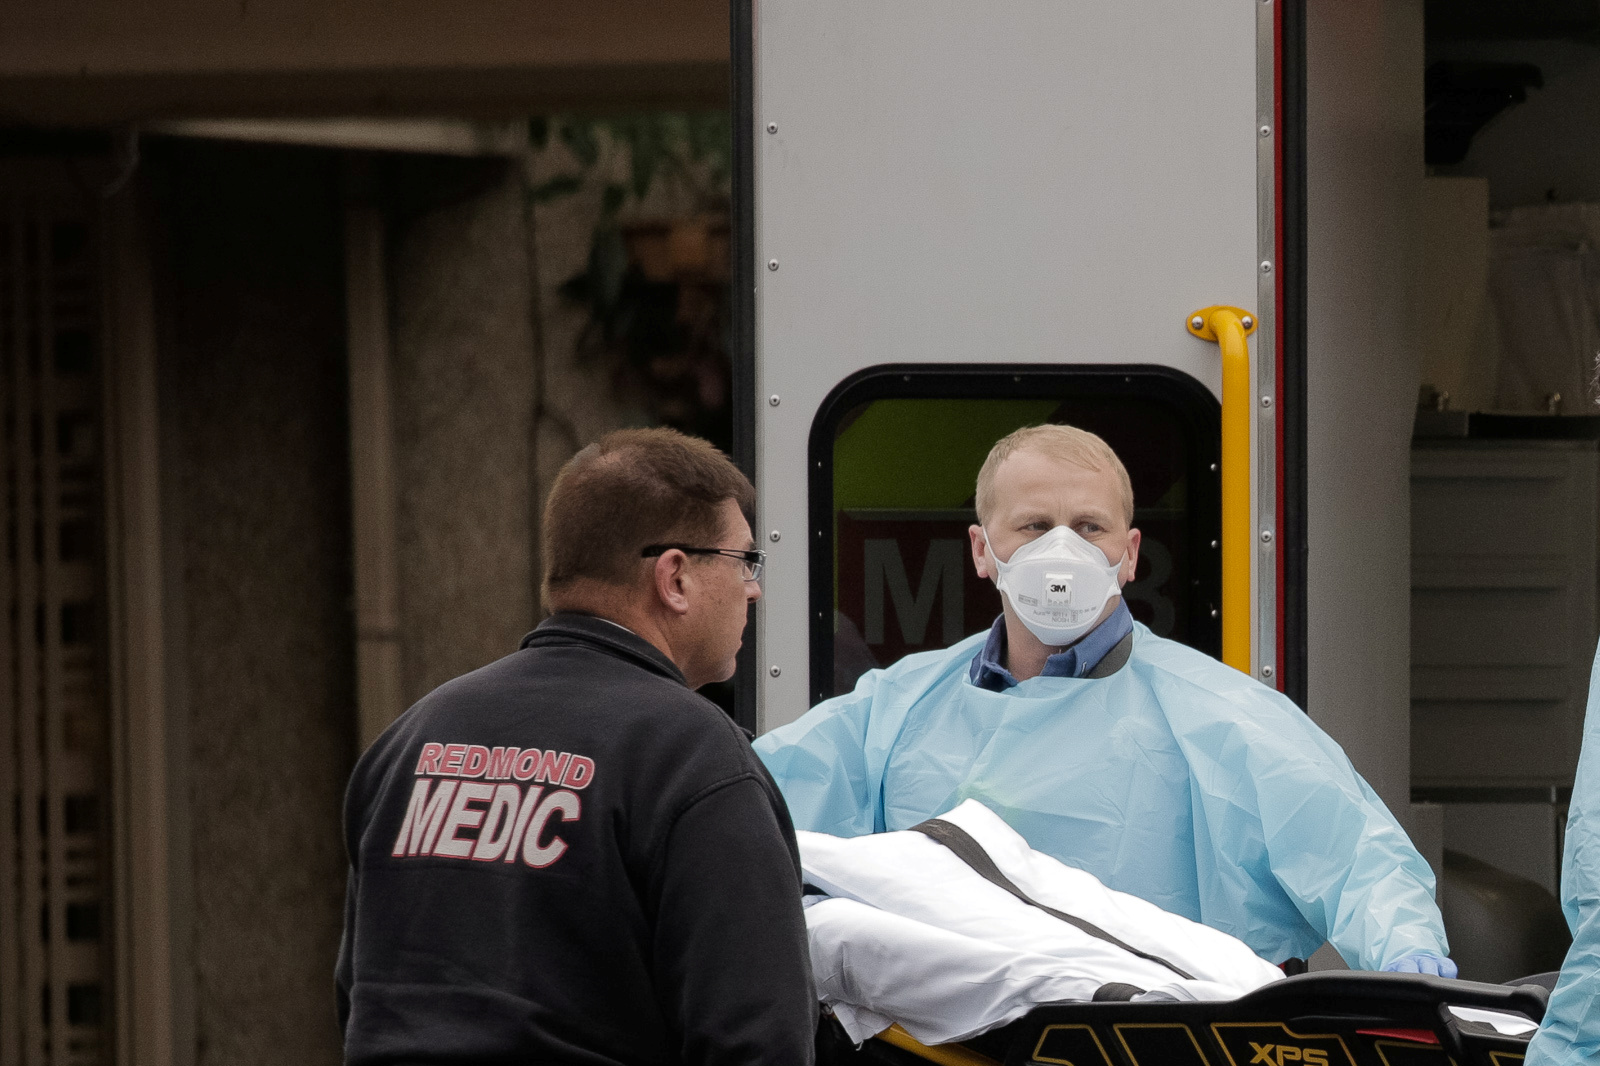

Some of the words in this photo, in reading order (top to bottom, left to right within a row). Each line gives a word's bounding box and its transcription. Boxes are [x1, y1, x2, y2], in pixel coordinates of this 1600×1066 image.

[1050, 584, 1067, 593] 3M
[414, 742, 595, 790] REDMOND
[392, 778, 582, 869] MEDIC
